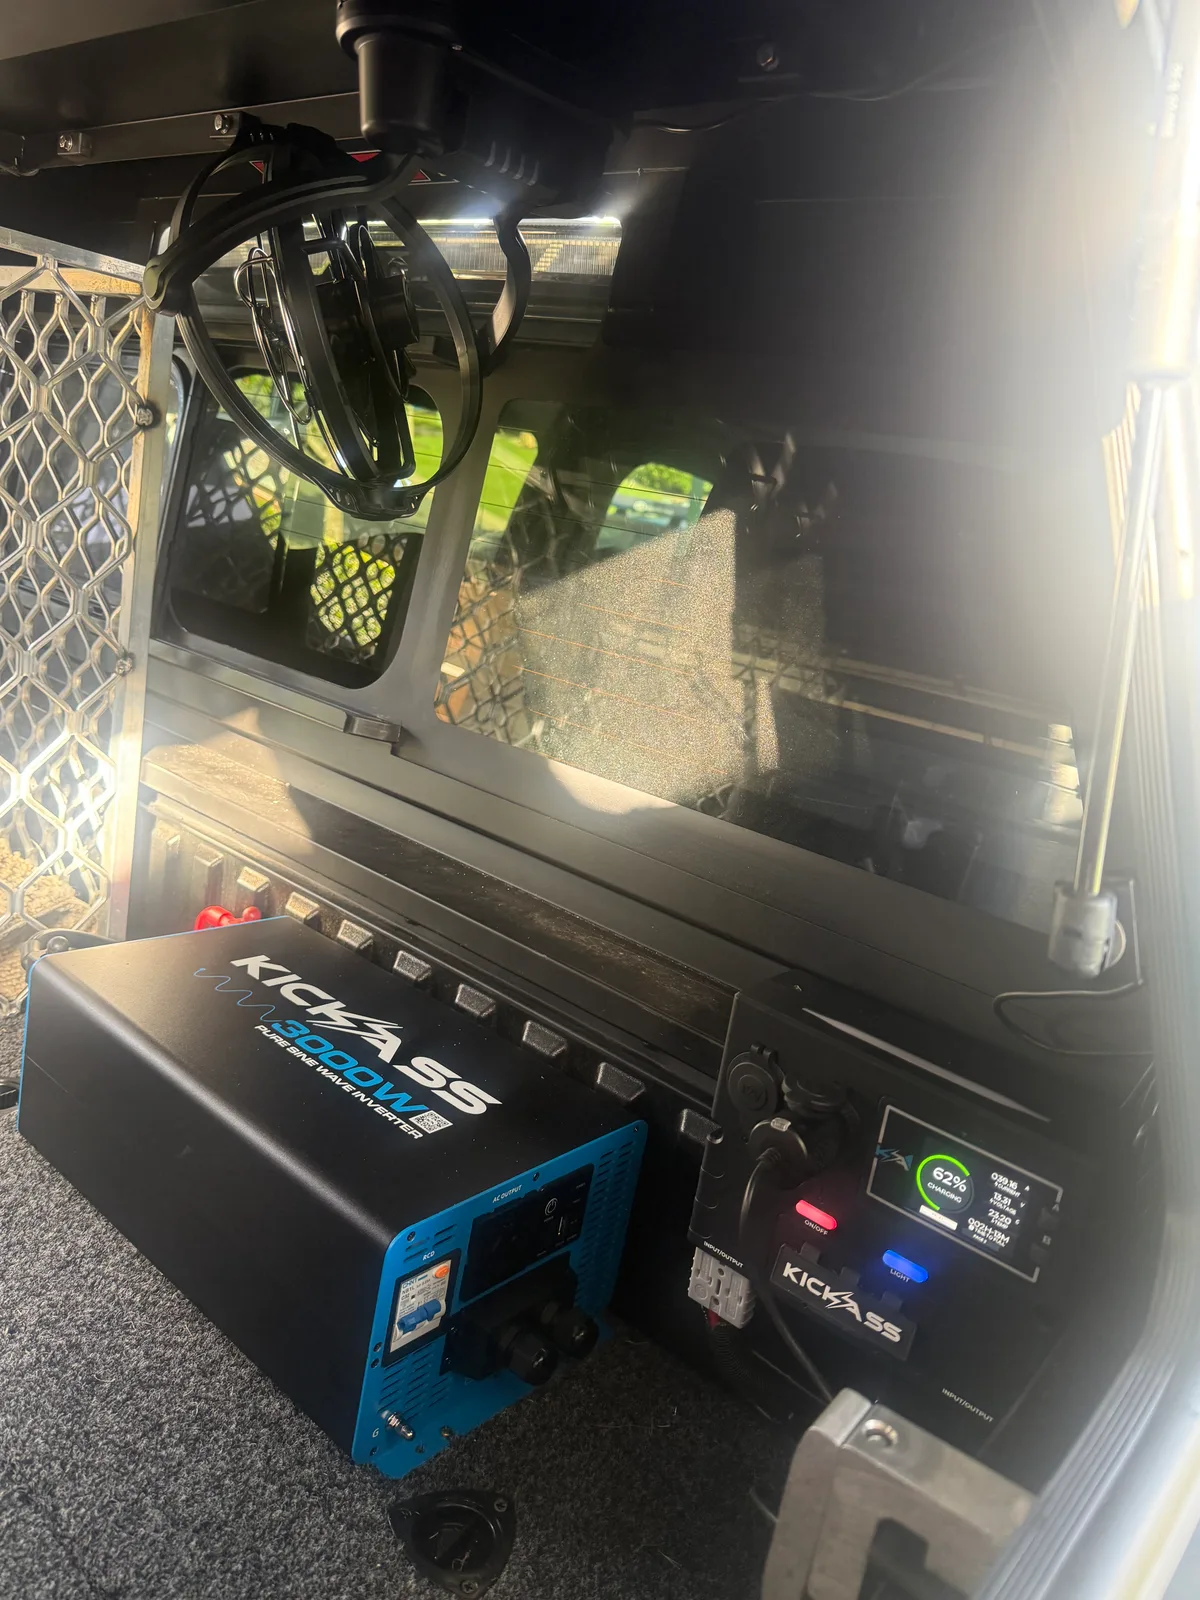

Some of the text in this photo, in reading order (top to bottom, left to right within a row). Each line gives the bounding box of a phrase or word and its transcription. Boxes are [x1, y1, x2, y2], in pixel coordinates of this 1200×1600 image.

[230, 954, 503, 1115] KICKASS
[271, 1019, 430, 1113] 3000W
[254, 1024, 424, 1140] PURE SINE WAVE INVERTER
[927, 1181, 962, 1204] CHARGING
[932, 1167, 967, 1193] 62%
[804, 1218, 829, 1236] ON/OFF
[422, 1250, 436, 1261] RCD
[703, 1240, 744, 1269] INPUT/OUTPUT
[889, 1268, 910, 1284] LIGHT
[782, 1261, 903, 1343] KICKASS
[941, 1387, 995, 1423] INPUT/OUTPUT
